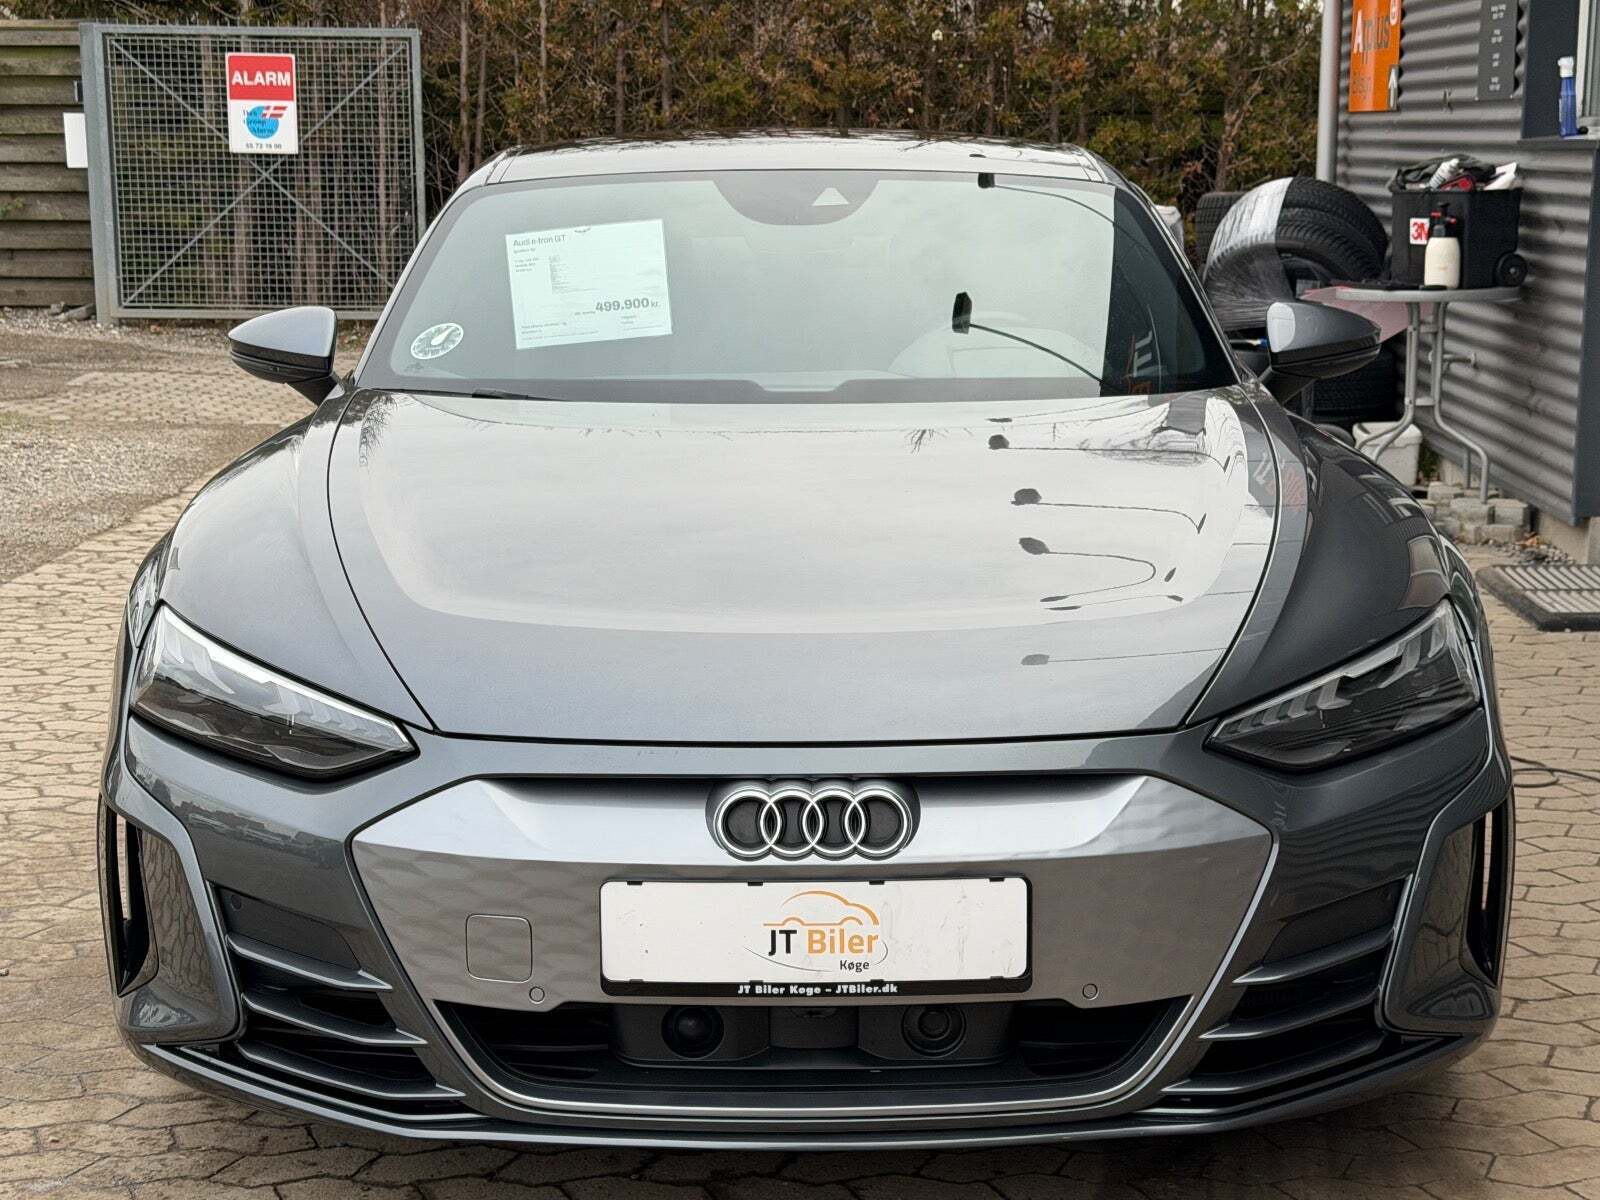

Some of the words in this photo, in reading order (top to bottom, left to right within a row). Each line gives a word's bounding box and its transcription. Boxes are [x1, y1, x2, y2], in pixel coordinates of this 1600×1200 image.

[231, 71, 291, 87] ALARM
[554, 234, 567, 243] GT
[595, 297, 650, 312] 499.900
[768, 929, 797, 956] JT
[807, 928, 879, 955] Biler
[839, 958, 870, 973] Køge
[737, 984, 752, 995] JT
[755, 984, 786, 995] Biler
[835, 983, 898, 995] JTBiler.dk
